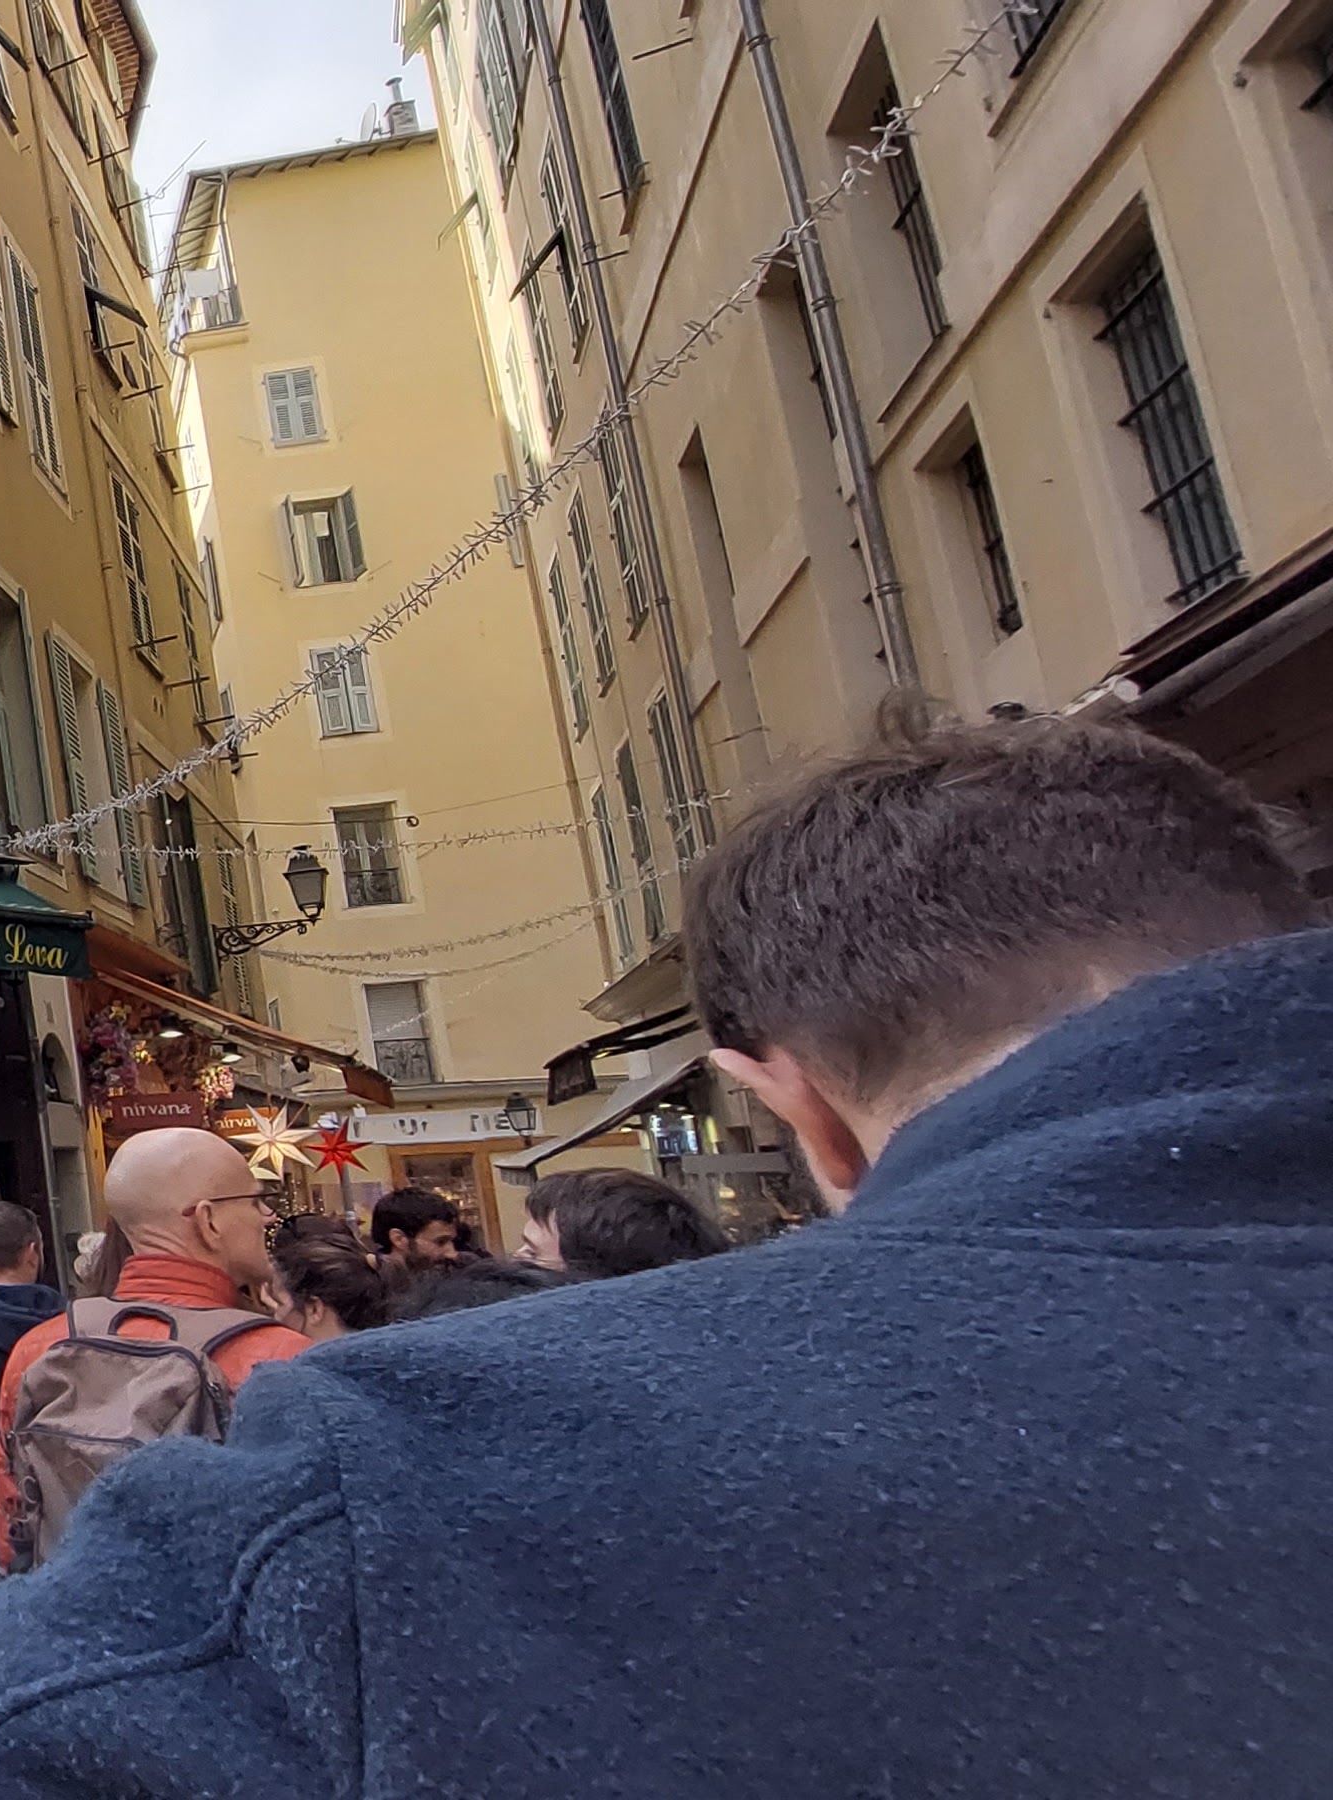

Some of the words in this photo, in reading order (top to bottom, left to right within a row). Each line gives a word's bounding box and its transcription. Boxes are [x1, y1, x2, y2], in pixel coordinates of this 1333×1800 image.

[4, 923, 71, 970] Leva
[122, 1102, 191, 1118] nirvana
[215, 1117, 271, 1131] nirva
